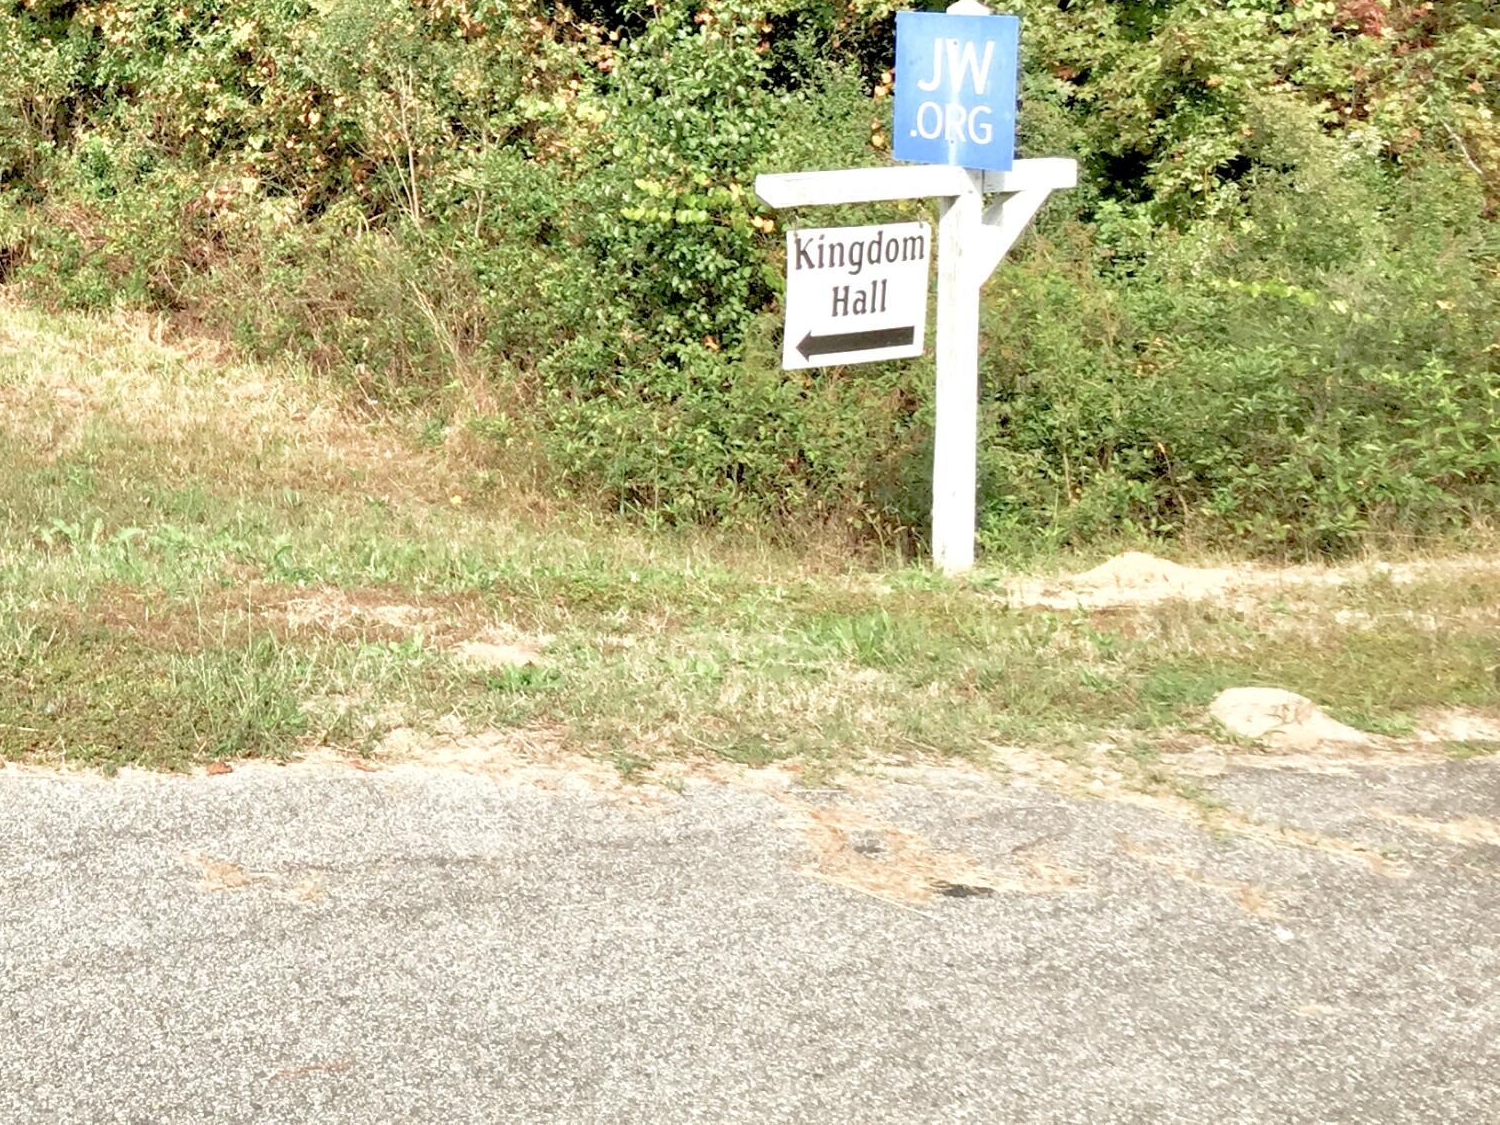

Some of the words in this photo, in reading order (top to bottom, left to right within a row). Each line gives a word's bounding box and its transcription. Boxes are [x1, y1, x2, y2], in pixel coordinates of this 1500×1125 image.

[917, 38, 995, 95] JW
[909, 101, 993, 145] .ORG
[794, 230, 925, 275] Kingdom
[831, 279, 888, 317] Hall
